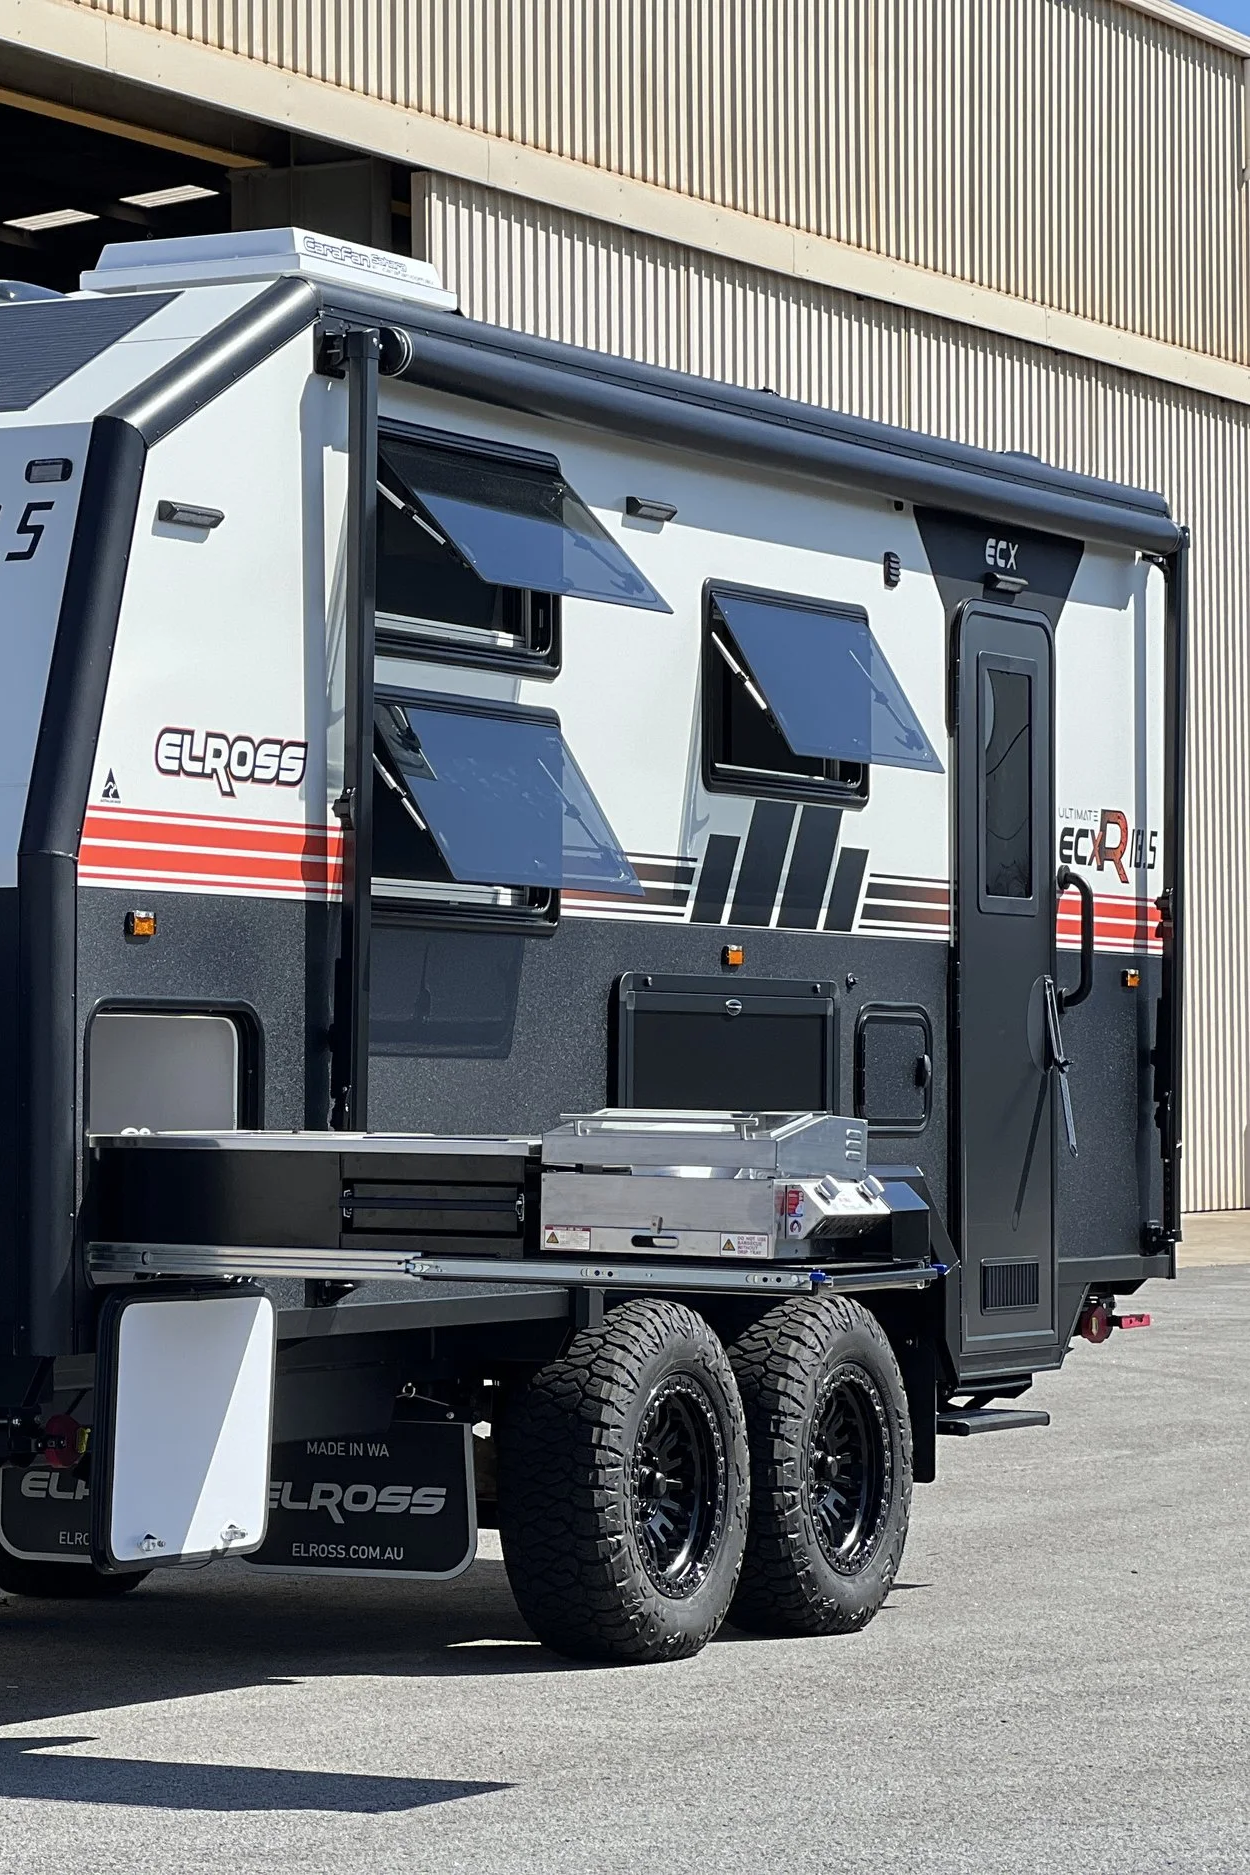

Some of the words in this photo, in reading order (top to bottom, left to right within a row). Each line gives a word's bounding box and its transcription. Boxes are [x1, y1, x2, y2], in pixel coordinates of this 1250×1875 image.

[985, 538, 1019, 571] ECX
[155, 726, 308, 799] ELROSS
[1058, 807, 1099, 822] ULTIMATE
[1129, 828, 1159, 870] 18.5
[306, 1441, 346, 1456] MADE
[349, 1442, 364, 1457] IN
[367, 1443, 390, 1457] WA
[292, 1543, 404, 1561] ELROSS.COM.AU
